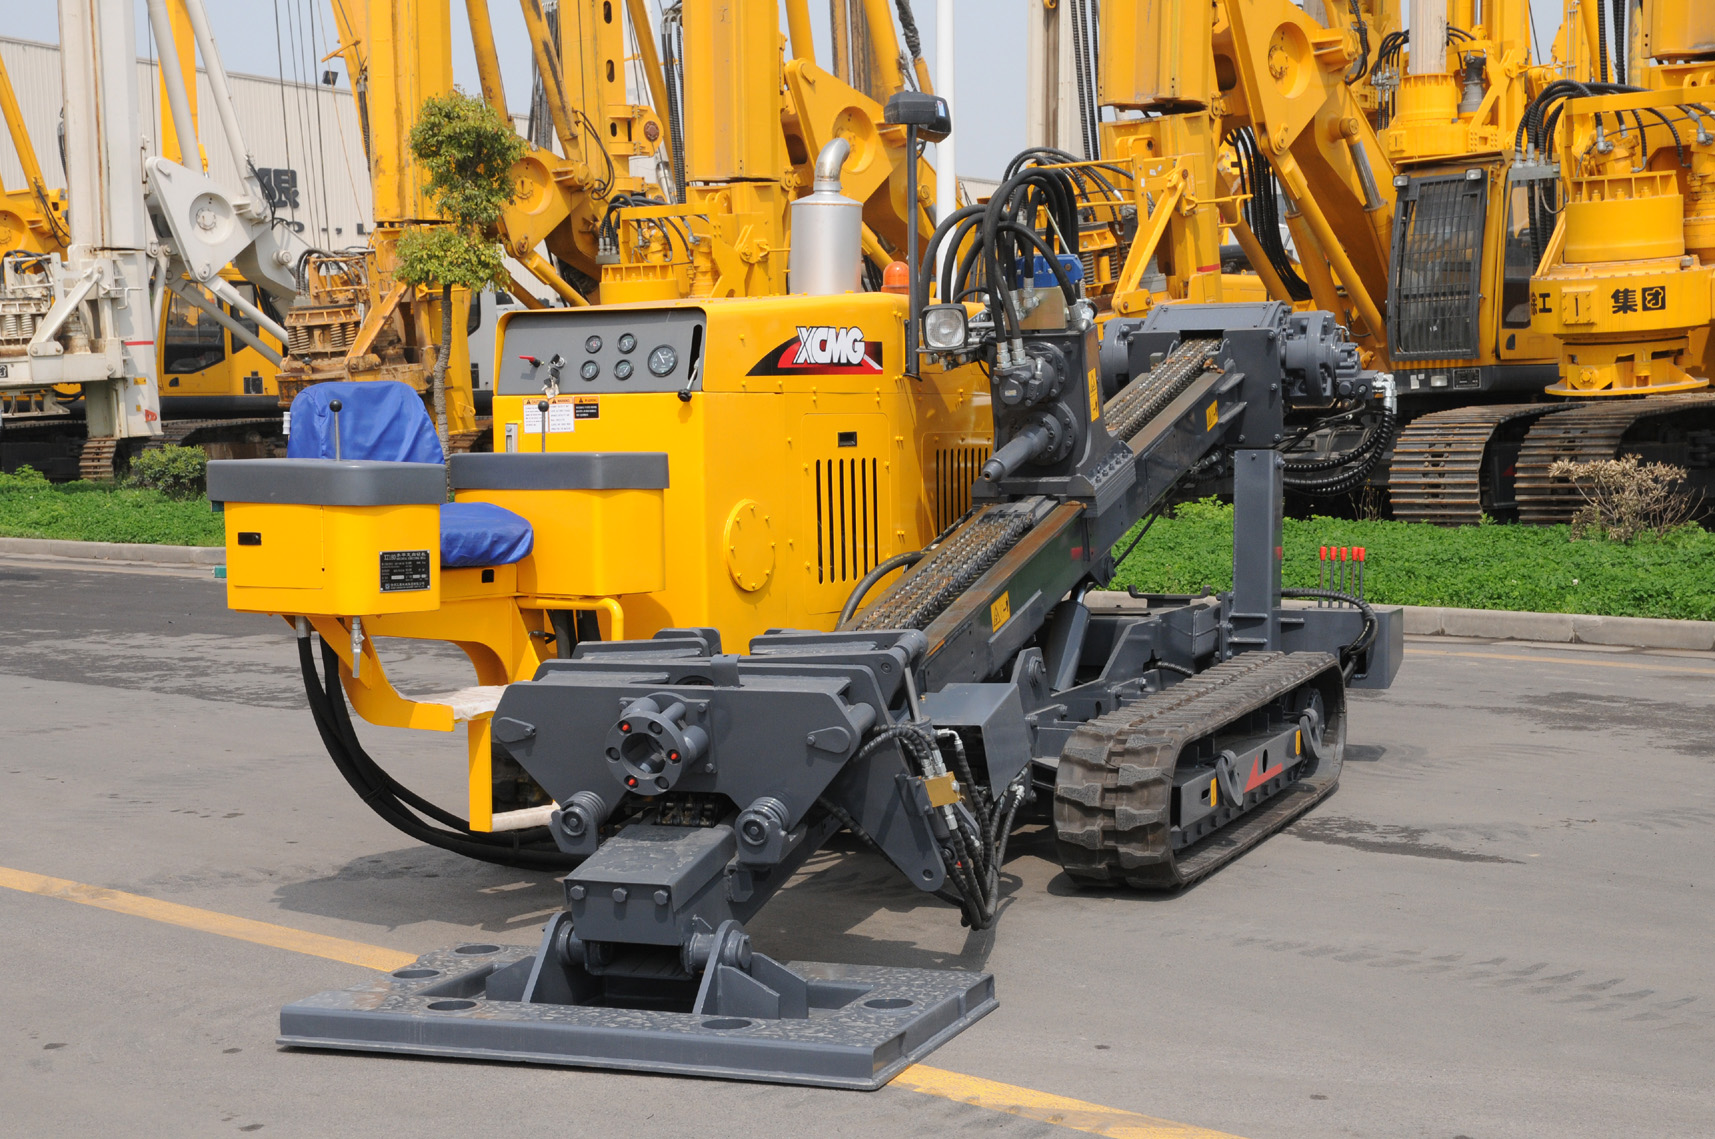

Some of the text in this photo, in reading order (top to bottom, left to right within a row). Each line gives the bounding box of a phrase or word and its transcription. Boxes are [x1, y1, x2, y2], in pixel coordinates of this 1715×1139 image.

[258, 168, 300, 208] 限
[1611, 286, 1666, 314] 集团
[792, 326, 865, 365] XCMG
